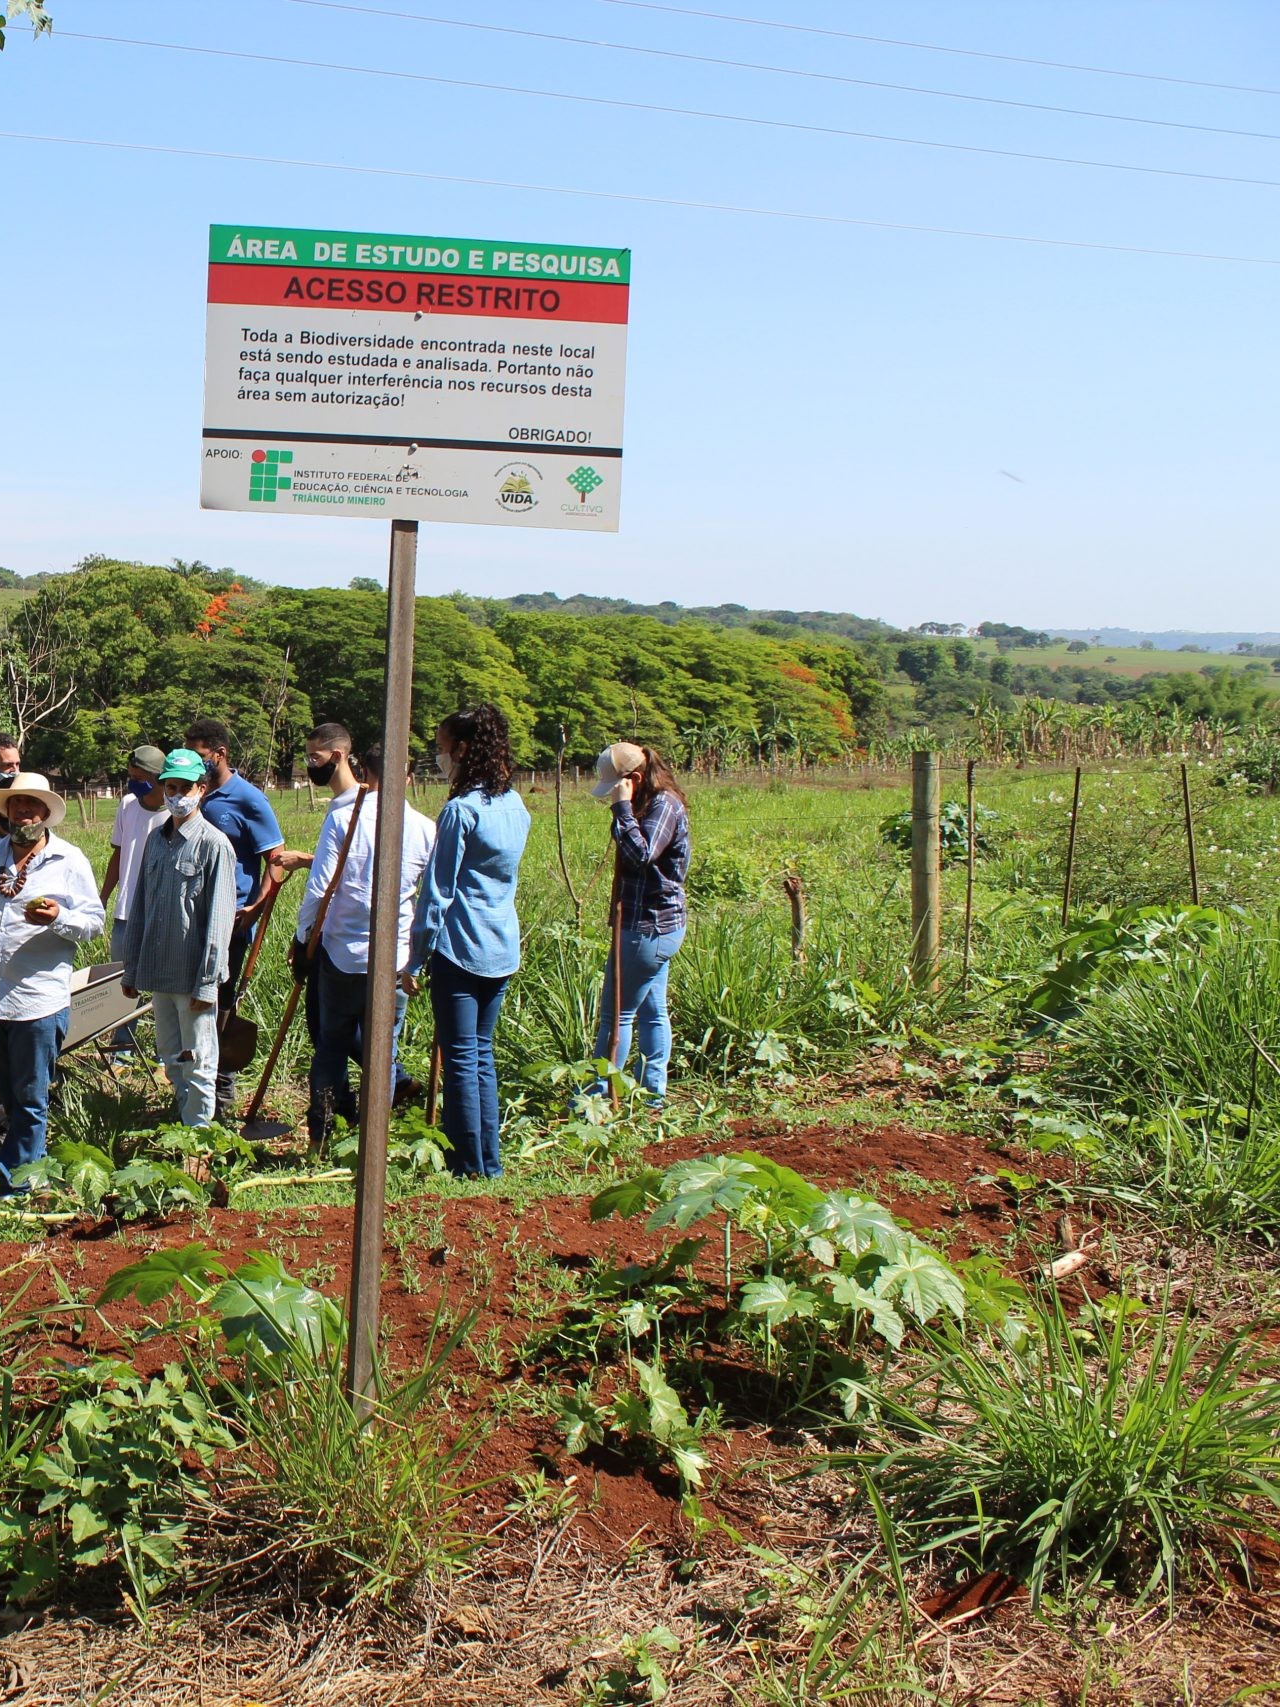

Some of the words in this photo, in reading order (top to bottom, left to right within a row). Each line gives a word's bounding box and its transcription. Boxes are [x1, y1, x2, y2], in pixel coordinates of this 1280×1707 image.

[226, 234, 298, 260] ÁREA
[314, 242, 347, 262] DE
[355, 244, 460, 268] ESTUDO
[468, 250, 484, 270] E
[492, 251, 620, 277] PESQUISA
[283, 276, 407, 304] ACESSO
[416, 283, 561, 312] RESTRITO
[241, 328, 277, 342] Toda
[284, 333, 293, 343] a
[300, 331, 414, 349] Biodiversidade
[420, 339, 506, 354] encontrada
[512, 344, 553, 357] neste
[559, 344, 595, 359] local
[239, 348, 271, 362] está
[276, 350, 323, 364] sendo
[328, 353, 398, 368] estudada
[402, 358, 411, 368] e
[416, 357, 492, 372] analisada.
[497, 360, 561, 377] Portanto
[566, 365, 593, 378] não
[238, 367, 270, 384] faça
[275, 370, 343, 386] qualquer
[347, 372, 443, 390] interferência
[448, 379, 475, 391] nos
[481, 381, 546, 395] recursos
[551, 383, 592, 397] desta
[237, 386, 270, 400] área
[275, 391, 306, 402] sem
[311, 391, 405, 409] autorização!
[508, 427, 592, 443] OBRIGADO!
[205, 449, 243, 459] APOIO:
[293, 470, 345, 479] INSTITUTO
[347, 472, 392, 482] FEDERAL
[395, 474, 409, 482] DE
[293, 482, 351, 493] EDUCAÇÃO,
[354, 484, 393, 494] CIÊNCIA
[405, 487, 469, 498] TECNOLOGIA
[501, 493, 533, 504] VIDA
[347, 496, 386, 506] MINEIRO
